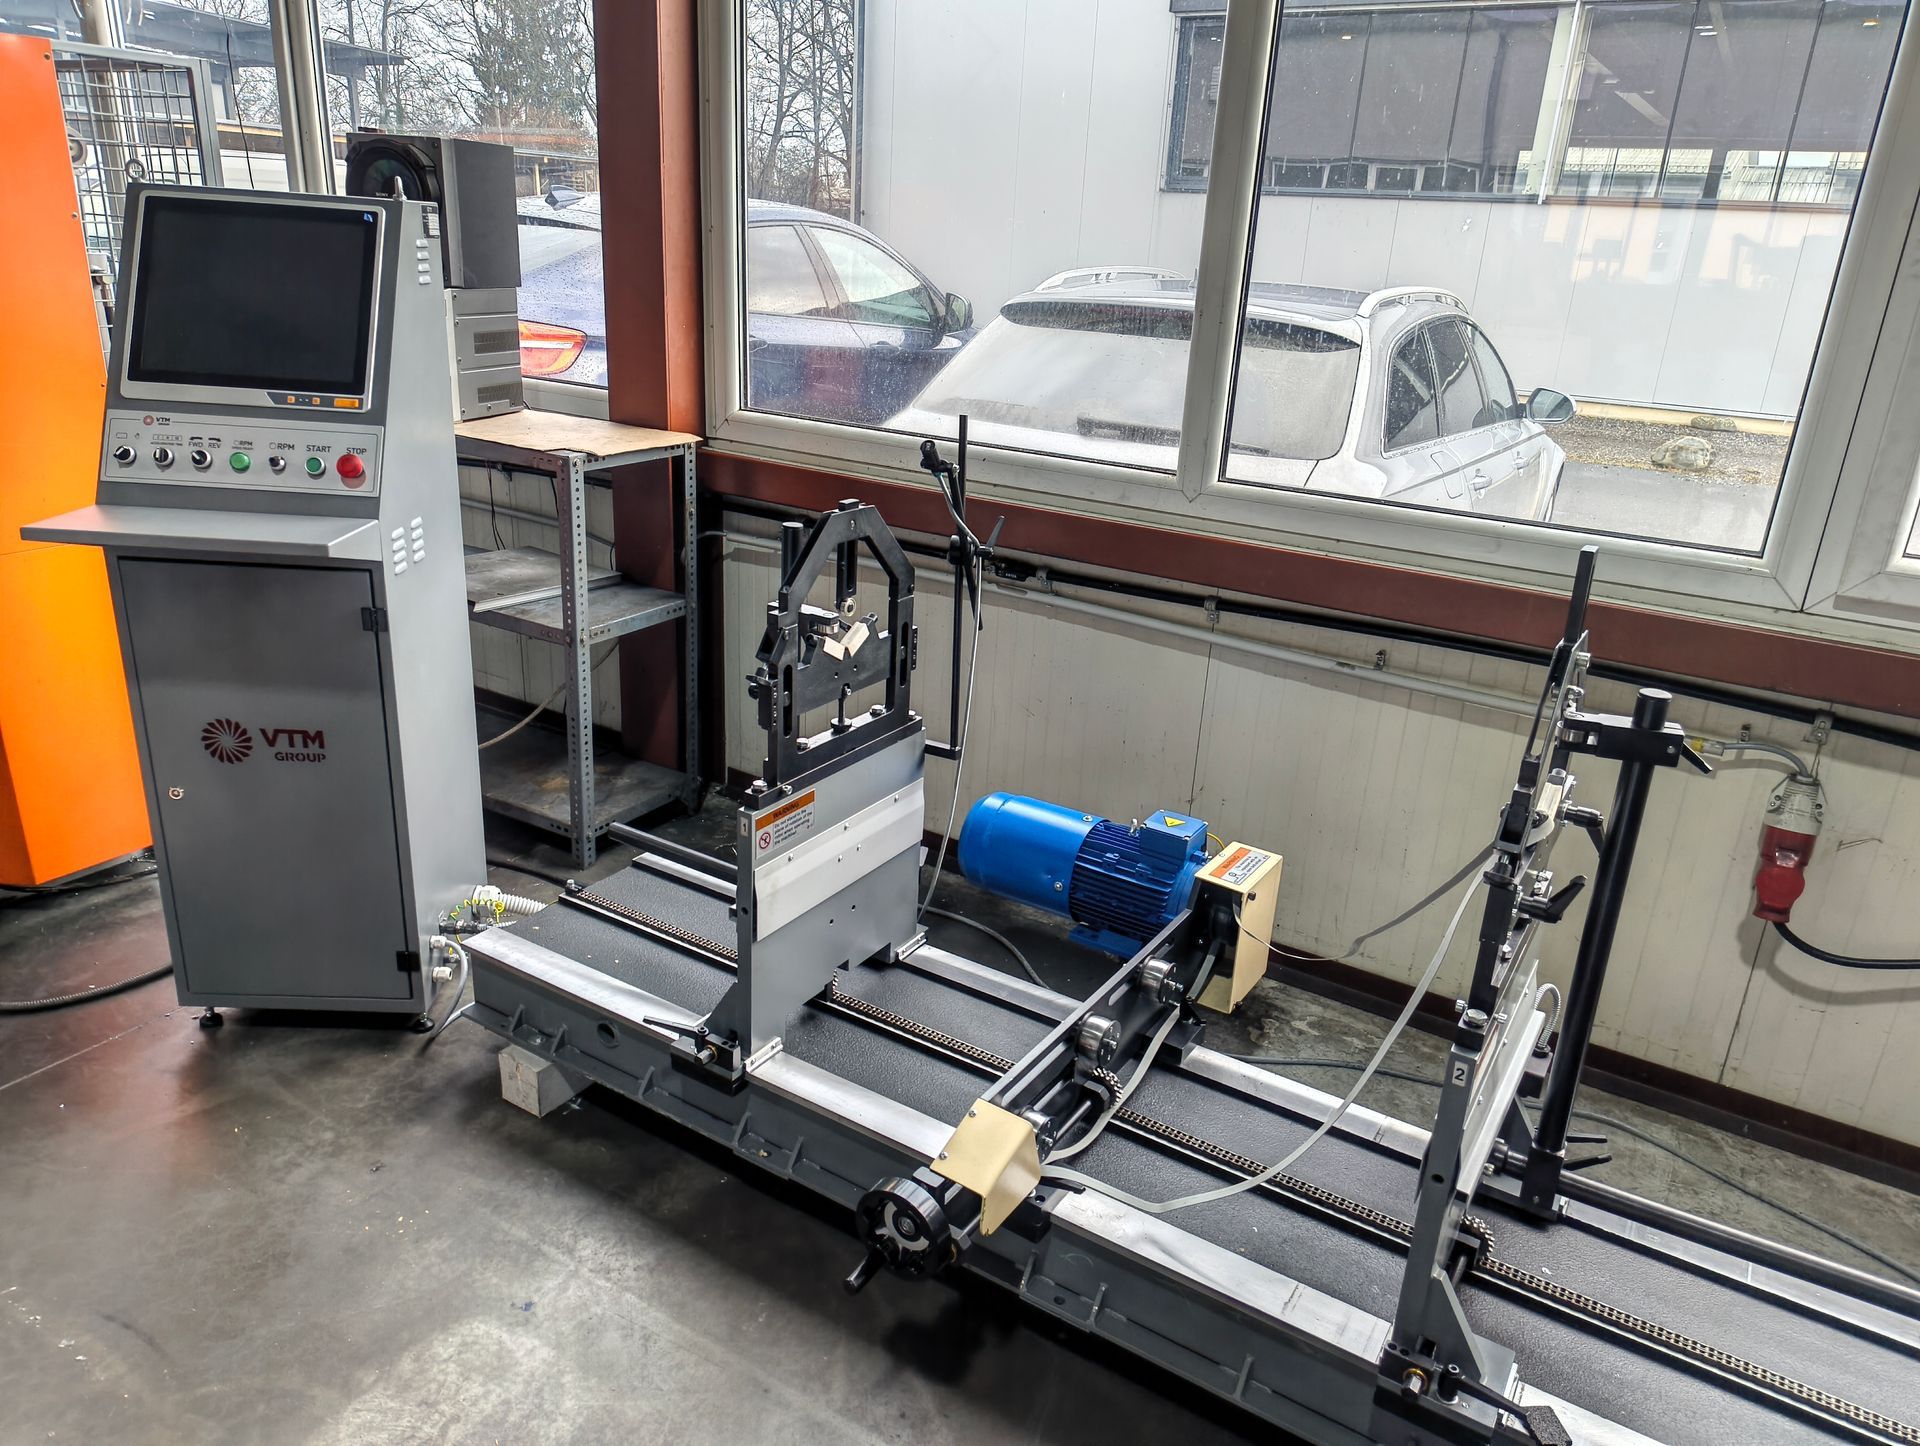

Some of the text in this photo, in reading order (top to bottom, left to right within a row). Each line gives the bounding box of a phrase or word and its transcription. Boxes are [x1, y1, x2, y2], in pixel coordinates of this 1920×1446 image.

[188, 441, 203, 449] FWD
[207, 442, 222, 450] REV
[276, 442, 295, 451] RPM
[305, 444, 332, 453] START
[345, 447, 367, 455] STOP
[258, 727, 325, 749] VTM
[274, 751, 327, 763] GROUP
[773, 803, 800, 819] WARNING
[743, 823, 747, 832] 1
[1454, 1067, 1465, 1081] 2
